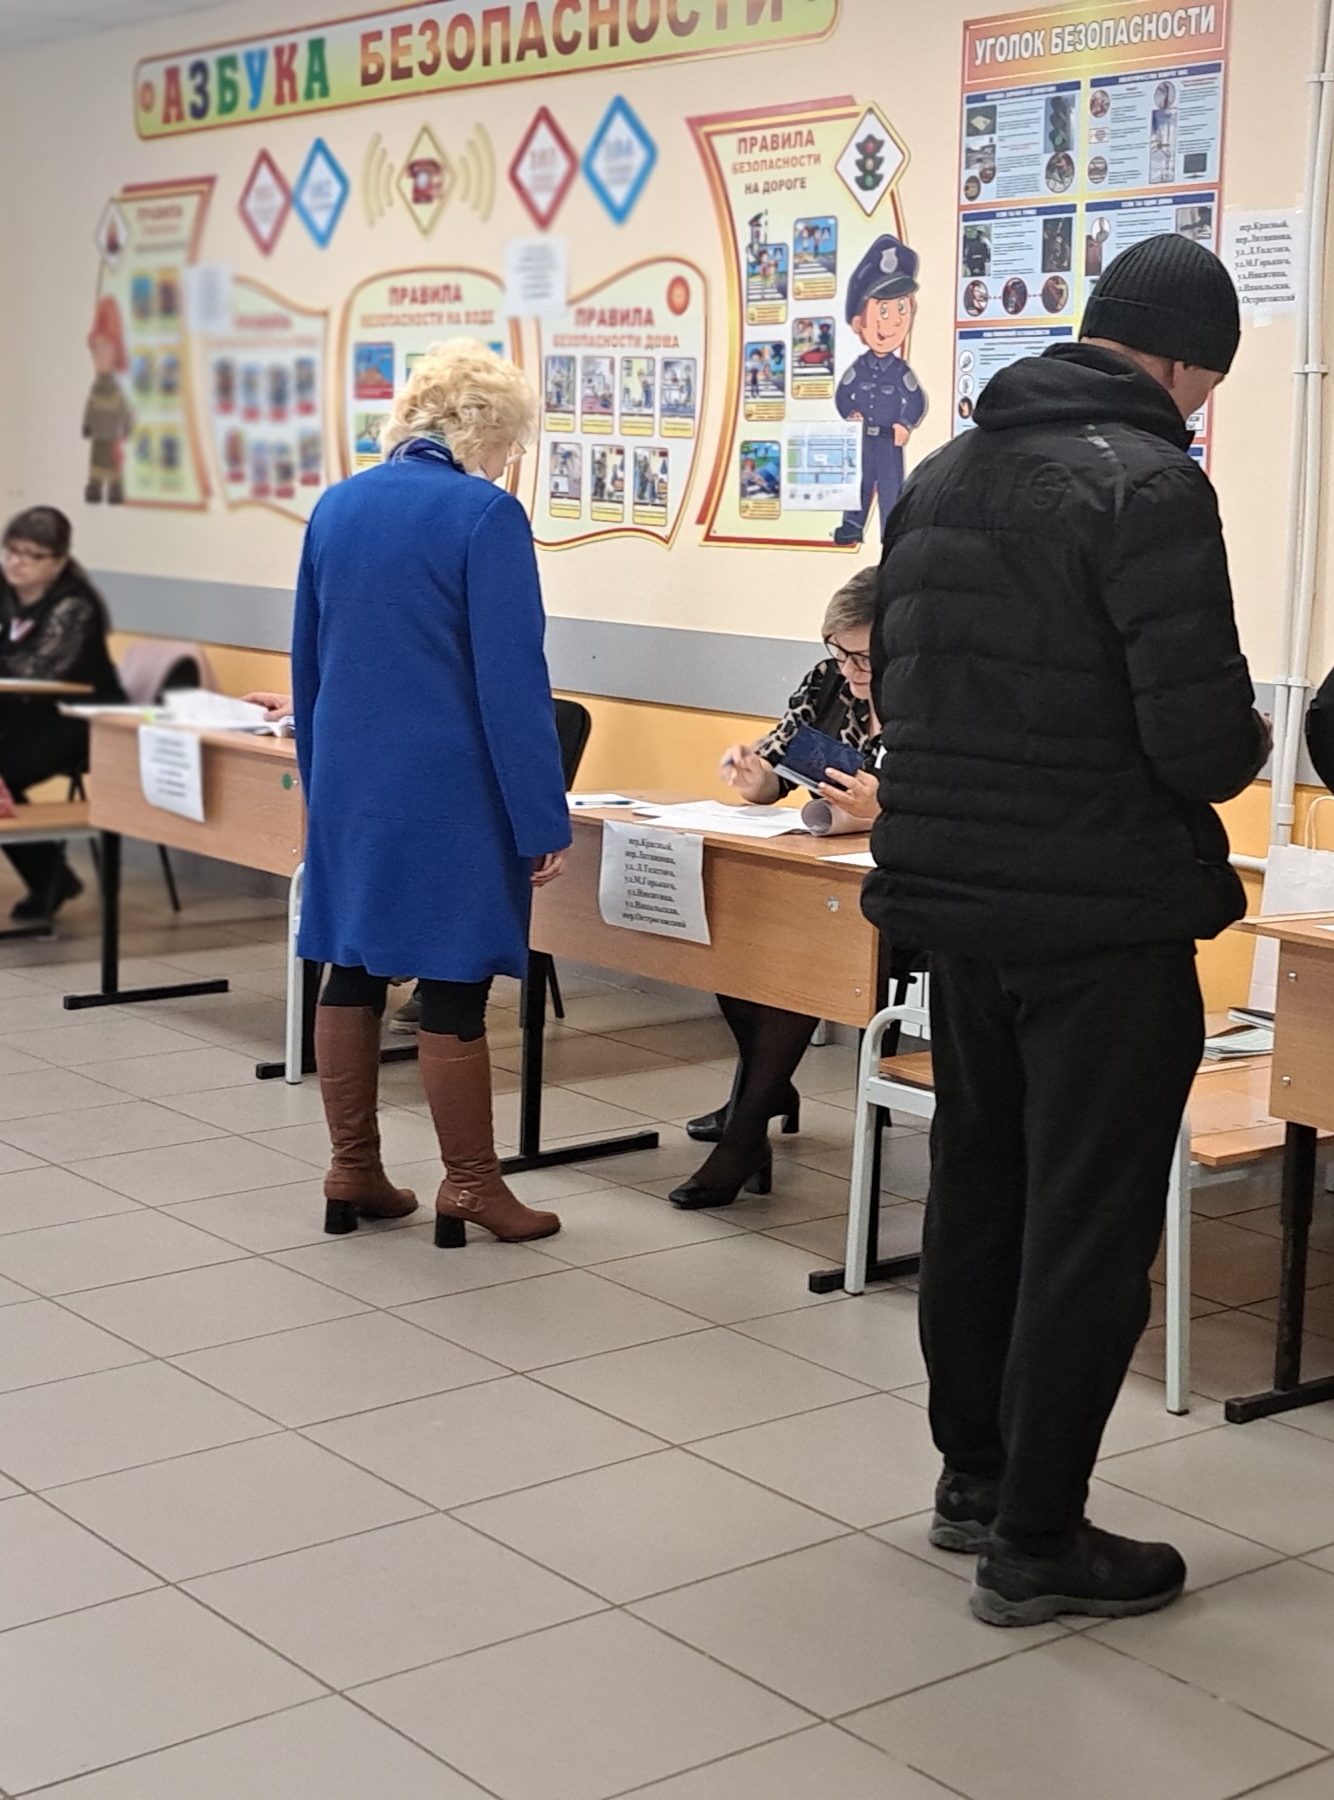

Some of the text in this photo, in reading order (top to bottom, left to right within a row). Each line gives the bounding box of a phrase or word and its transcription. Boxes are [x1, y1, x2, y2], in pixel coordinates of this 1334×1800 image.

[973, 4, 1216, 66] УГОЛОК БЕЗОПАСНОСТИ
[162, 37, 330, 124] АЗБУКА
[737, 129, 816, 155] ПРАВИЛА
[732, 154, 822, 175] БЕЗОПАСНОСТИ
[745, 177, 807, 195] НА ДОРОГЕ
[388, 283, 464, 306] ПРАВИЛА
[575, 306, 655, 327] ПРАВИЛА
[645, 334, 680, 350] ДОМА
